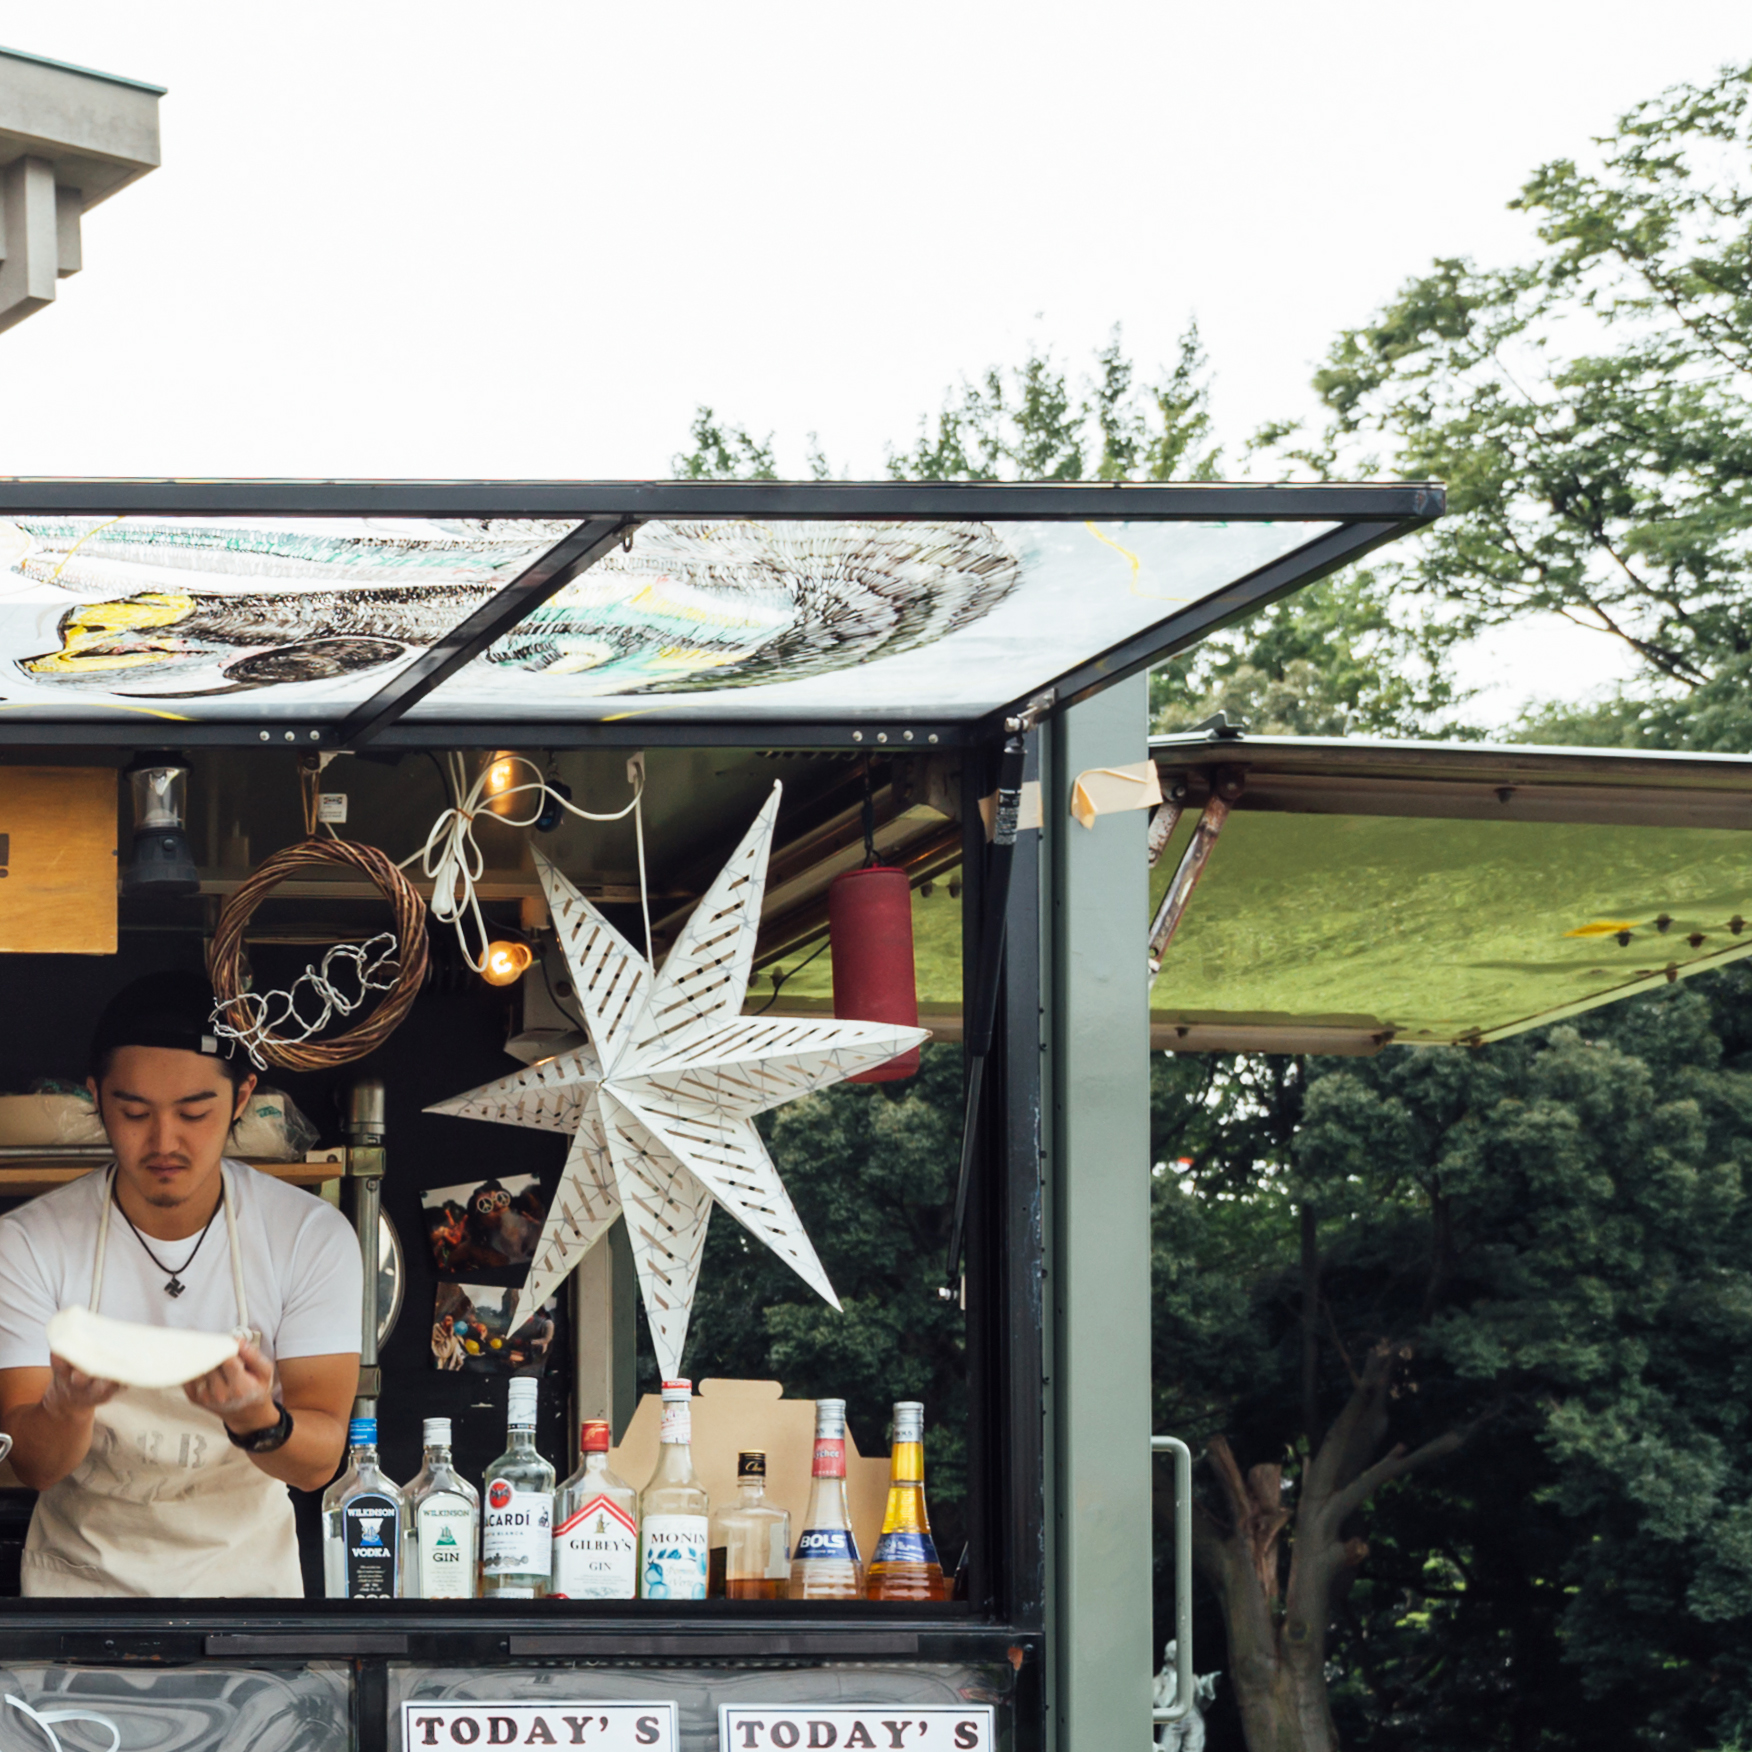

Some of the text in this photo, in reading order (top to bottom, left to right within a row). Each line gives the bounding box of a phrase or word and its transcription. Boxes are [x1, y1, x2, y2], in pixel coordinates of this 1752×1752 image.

[347, 1508, 470, 1518] WILKINSON WILKINSON
[570, 1539, 632, 1552] GILBEY'S
[800, 1534, 845, 1548] BOLS
[352, 1548, 460, 1562] VODKA GIN
[589, 1563, 611, 1571] GIN
